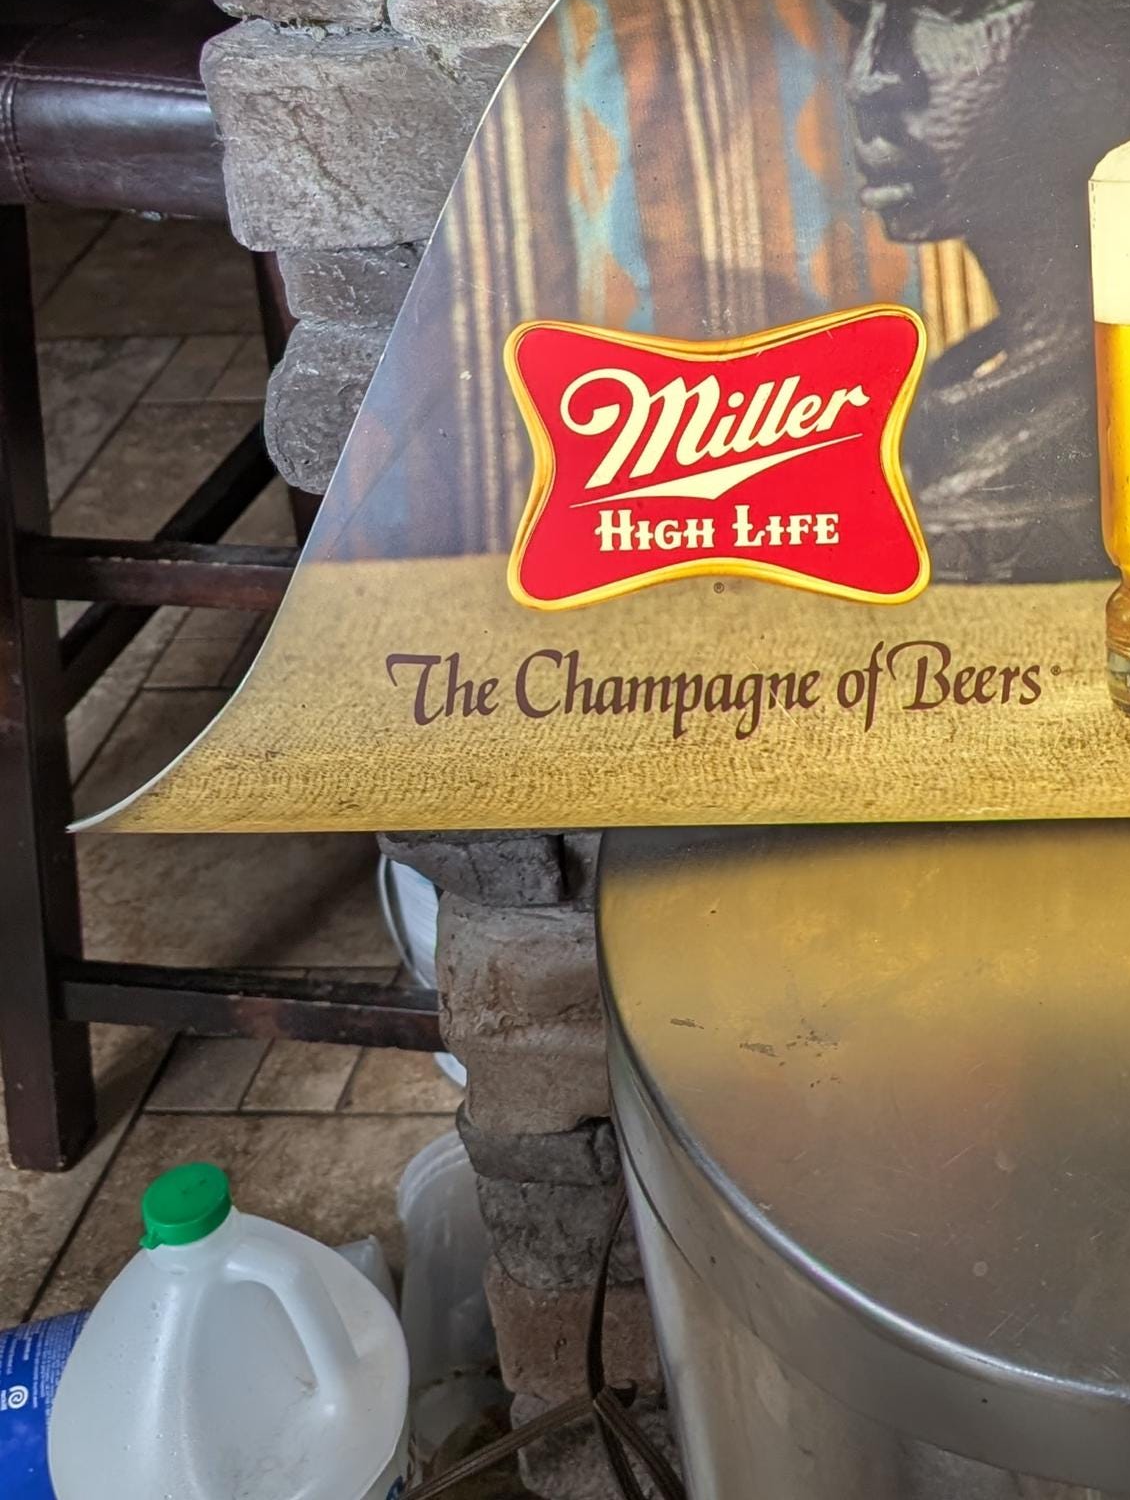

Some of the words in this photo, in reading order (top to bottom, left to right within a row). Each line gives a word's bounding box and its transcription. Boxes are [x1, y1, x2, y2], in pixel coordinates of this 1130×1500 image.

[560, 367, 870, 489] Miller
[594, 509, 715, 552] HIGH
[731, 503, 840, 548] LIFE
[385, 651, 499, 726] The
[514, 647, 819, 740] Champagne
[836, 639, 886, 732] of
